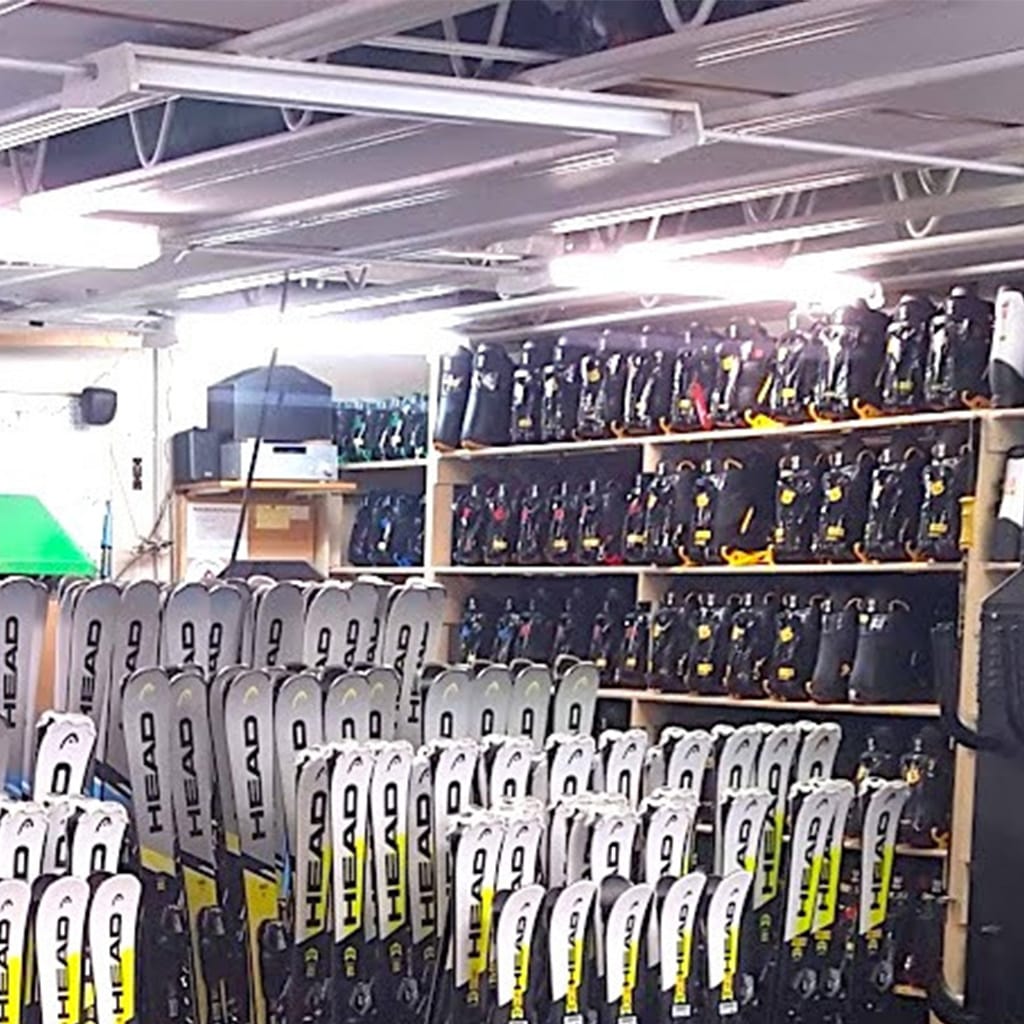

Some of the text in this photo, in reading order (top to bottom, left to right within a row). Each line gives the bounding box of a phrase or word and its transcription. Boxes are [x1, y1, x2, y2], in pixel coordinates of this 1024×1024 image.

[4, 616, 18, 728] HEAD
[126, 620, 143, 672] AD
[209, 622, 223, 677] AD
[266, 618, 282, 666] AD
[344, 619, 359, 666] AD
[140, 712, 163, 833] HEAD
[179, 717, 203, 838] HEAD
[244, 715, 265, 840] HEAD
[305, 790, 327, 928] HEAD
[342, 784, 358, 926] HEAD
[384, 782, 402, 922] HEAD
[417, 793, 434, 927] HEAD
[736, 818, 752, 871] AD
[797, 817, 821, 918] HEAD
[870, 811, 891, 910] HEAD
[467, 848, 487, 958] HEAD
[567, 911, 580, 988] HEAD
[623, 914, 636, 993] HEAD
[675, 903, 689, 981] HEAD
[723, 901, 737, 979] HEAD
[56, 915, 70, 1019] HEAD
[108, 913, 124, 1015] HEAD
[513, 916, 527, 992] HEAD
